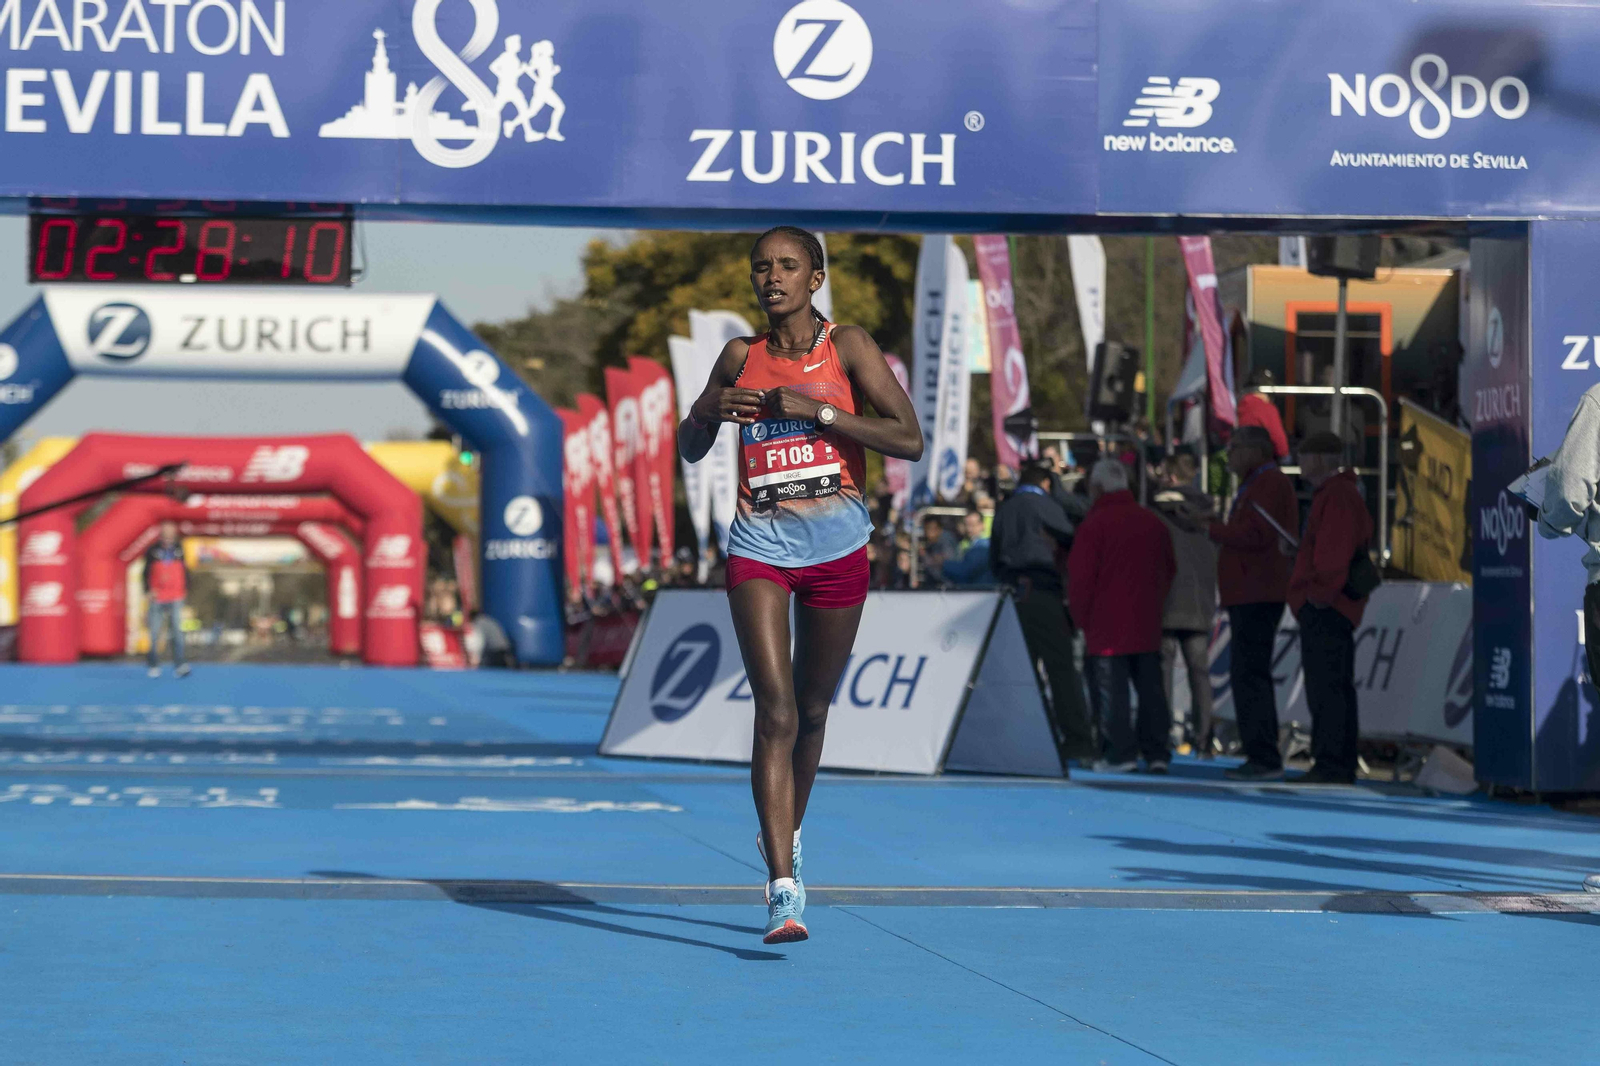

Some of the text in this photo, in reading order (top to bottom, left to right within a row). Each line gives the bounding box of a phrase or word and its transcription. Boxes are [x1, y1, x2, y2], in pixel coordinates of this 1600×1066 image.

[1103, 134, 1147, 151] new
[685, 130, 957, 186] ZURICH
[1330, 150, 1529, 170] AYUNTAMIENTO DE SEVILLA
[35, 218, 346, 283] 02:28:10
[180, 315, 371, 352] ZURICH
[1476, 384, 1520, 422] ZURICH
[770, 420, 816, 435] ZURIC
[766, 444, 815, 469] F108
[815, 486, 838, 496] ZURICH
[486, 539, 557, 559] ZURICH
